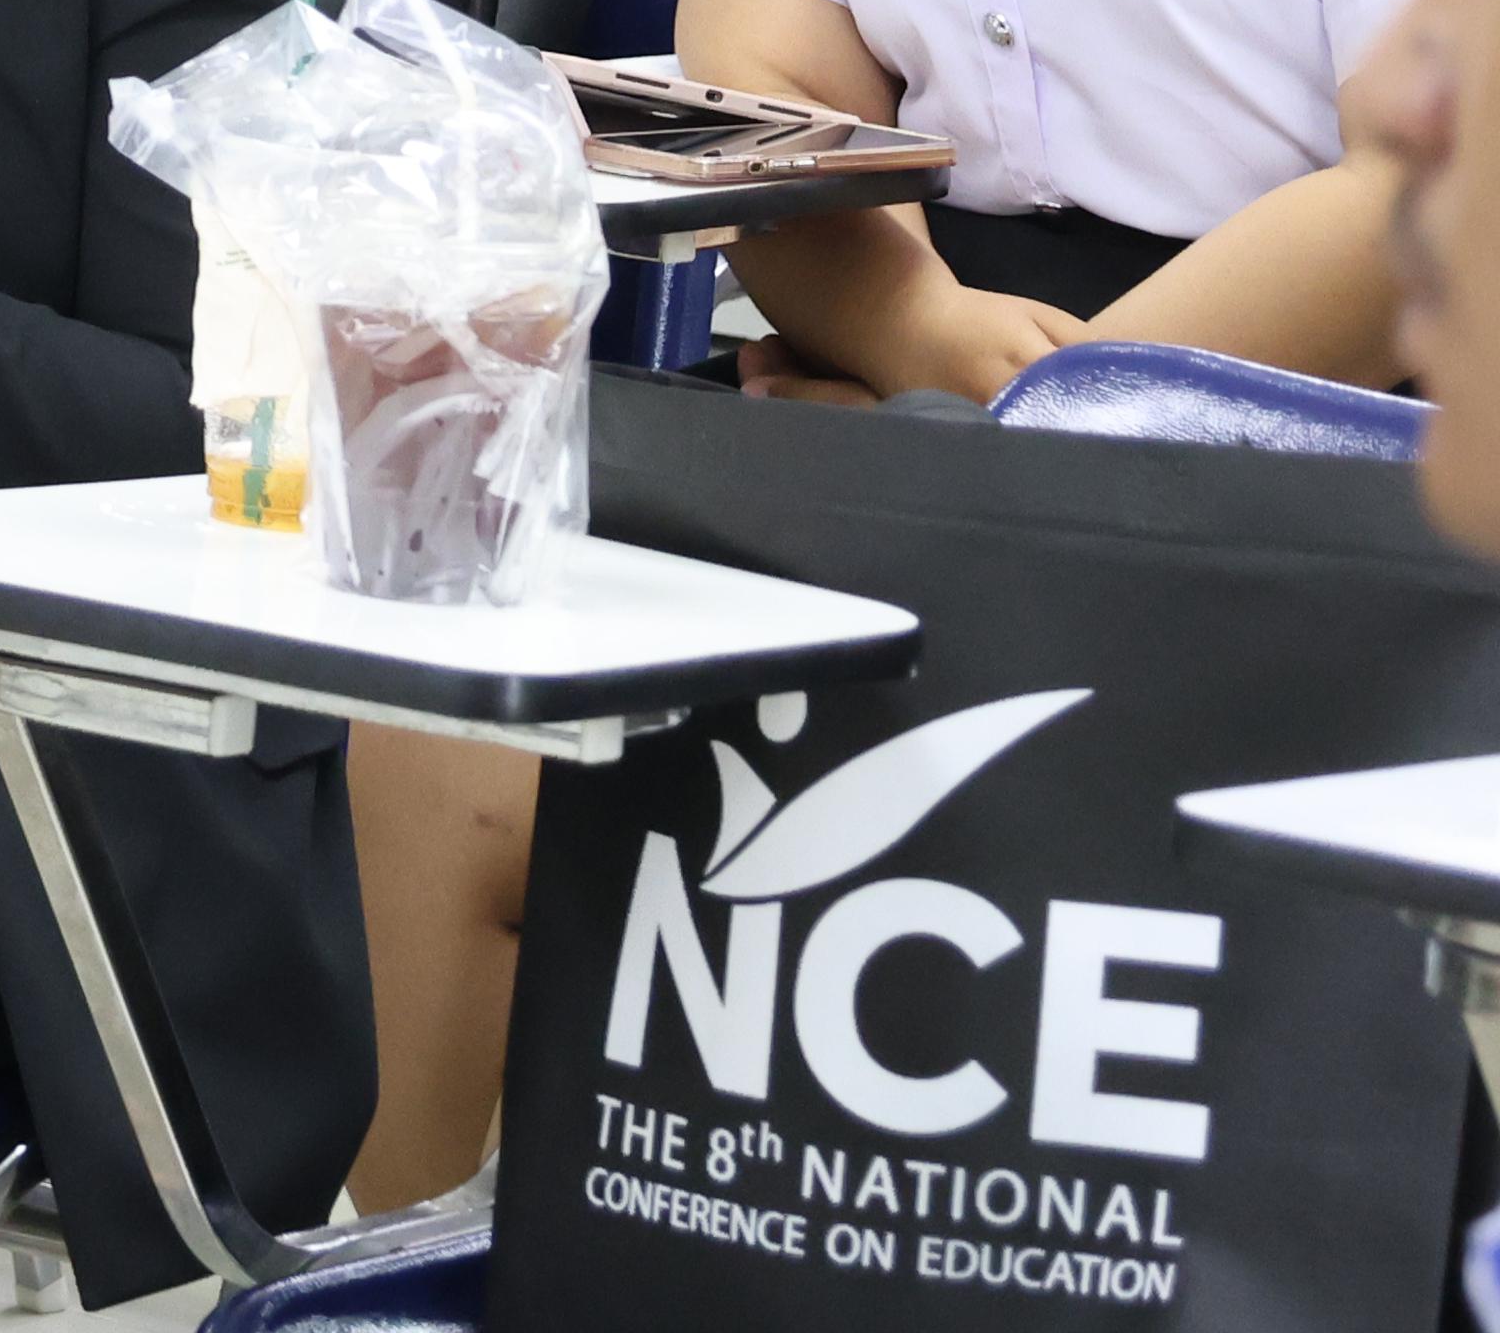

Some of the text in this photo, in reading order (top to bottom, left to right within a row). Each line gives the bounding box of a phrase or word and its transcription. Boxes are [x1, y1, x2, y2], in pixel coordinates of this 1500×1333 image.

[585, 1165, 1178, 1303] CONFERENCE ON EDUCATION
[596, 1093, 1185, 1250] THE 8th NATIONAL
